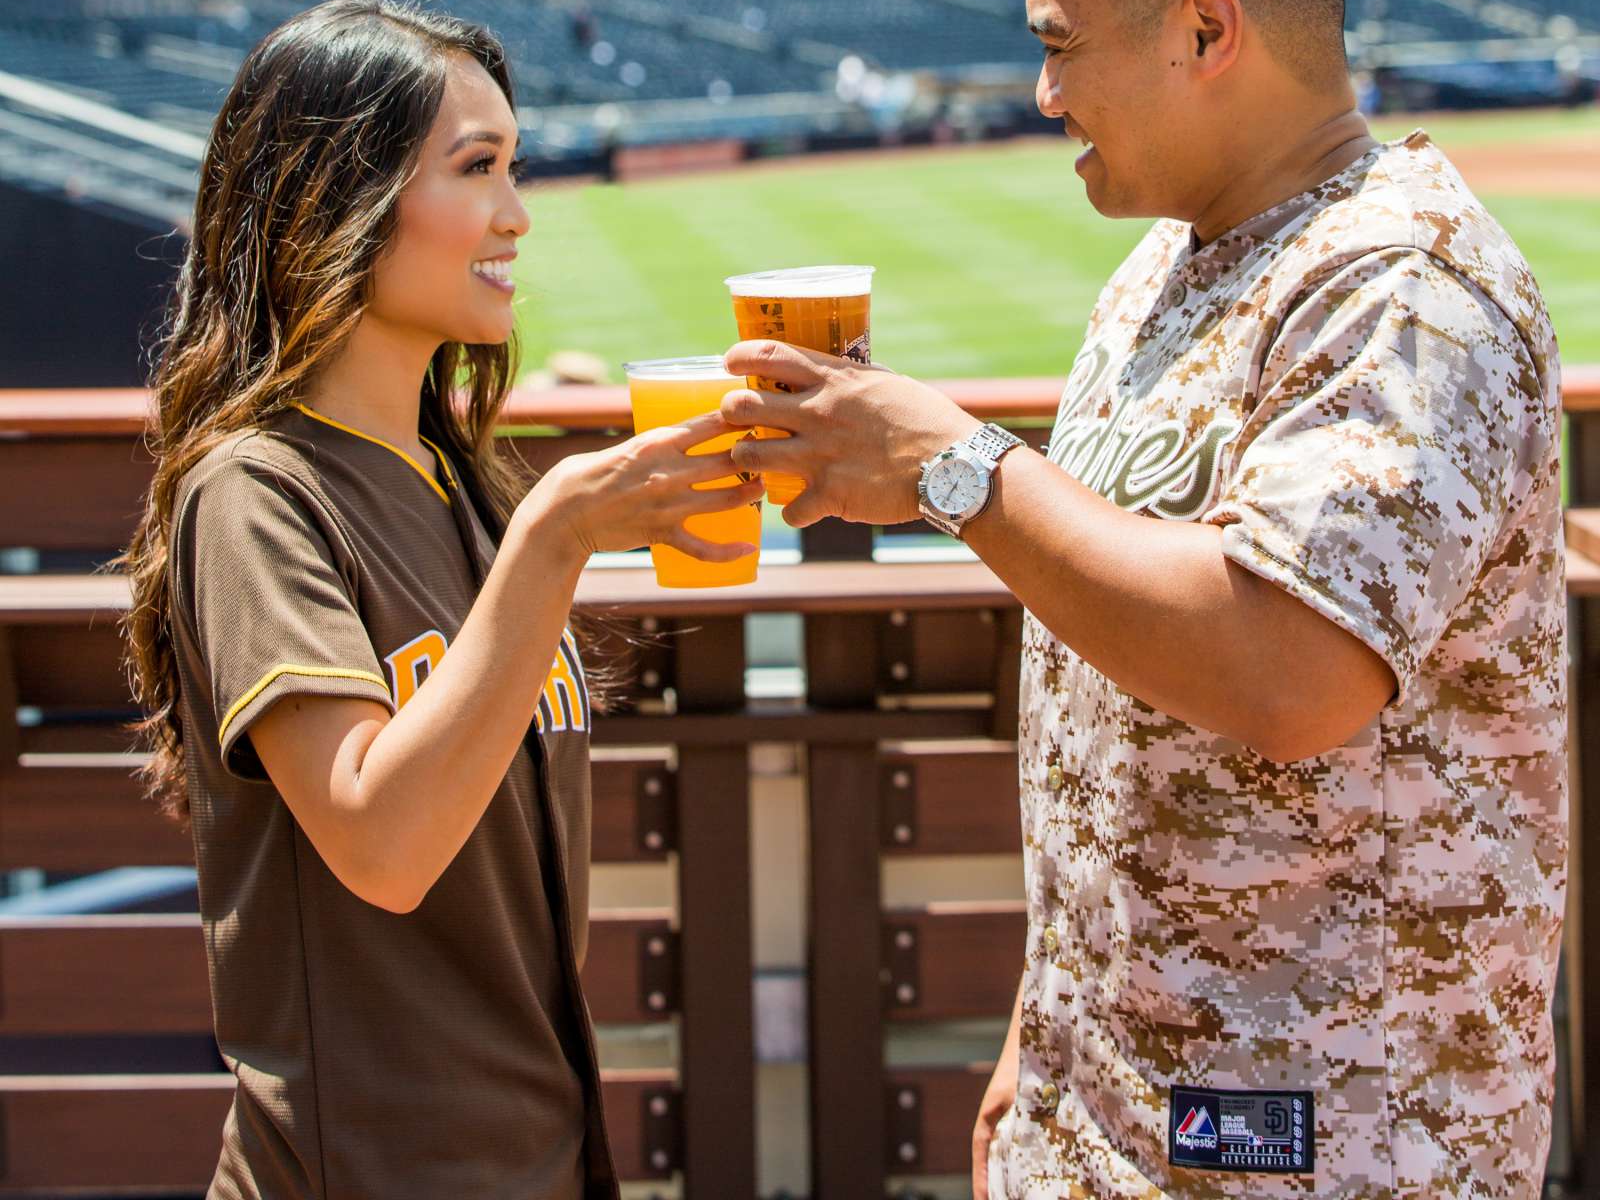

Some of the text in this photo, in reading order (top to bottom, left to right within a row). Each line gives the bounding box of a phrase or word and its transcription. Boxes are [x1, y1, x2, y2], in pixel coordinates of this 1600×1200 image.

[1264, 1100, 1288, 1135] SD
[1176, 1133, 1217, 1150] Majestic
[1230, 1144, 1281, 1154] GENUINE
[1221, 1155, 1290, 1166] MERCHANDISE
